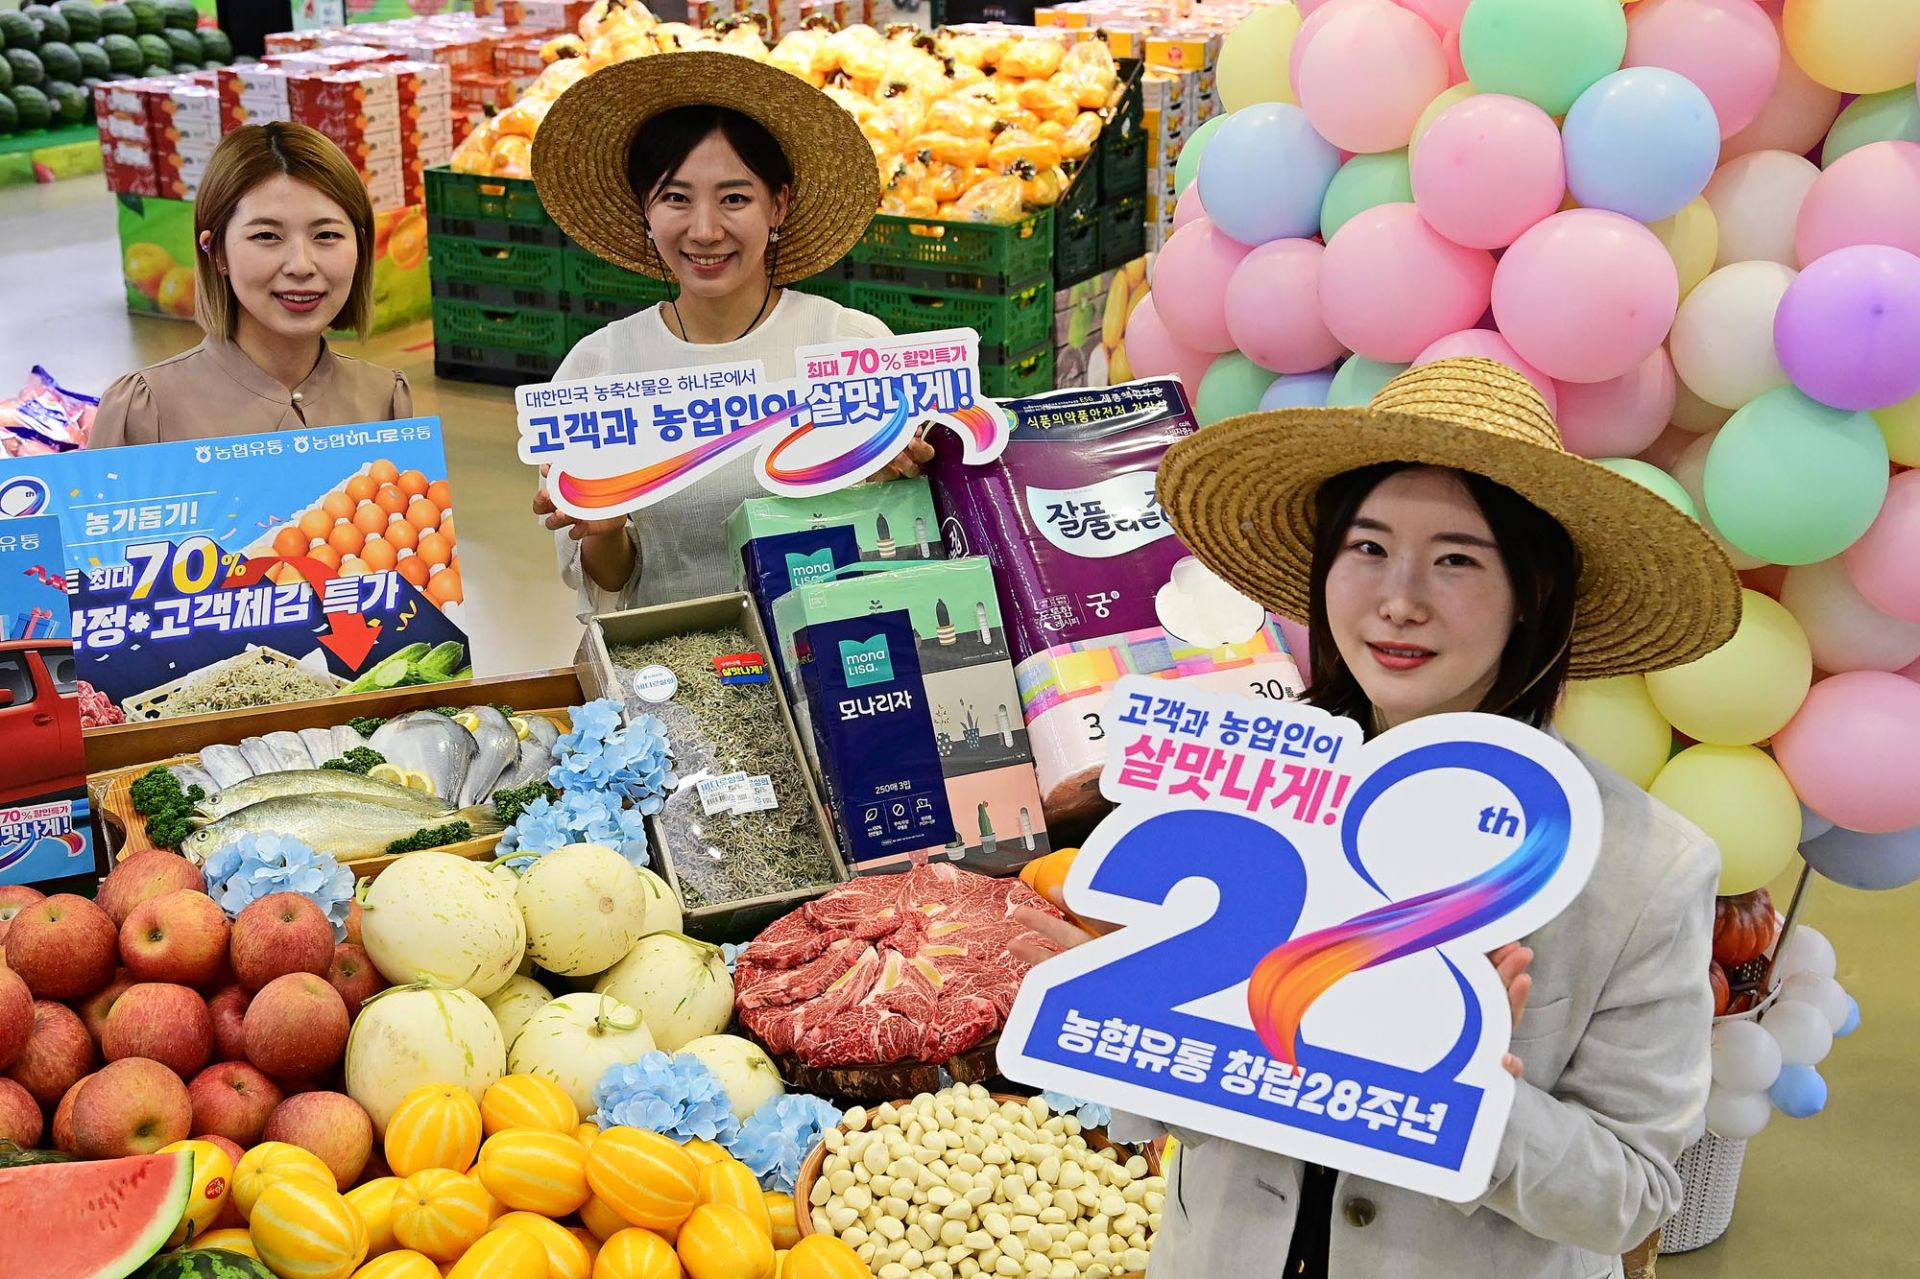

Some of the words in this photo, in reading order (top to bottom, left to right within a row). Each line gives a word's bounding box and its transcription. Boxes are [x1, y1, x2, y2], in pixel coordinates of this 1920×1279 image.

[807, 360, 839, 379] 최대
[842, 348, 902, 377] 70%
[903, 344, 968, 367] 할인특가
[525, 383, 589, 409] 대한민국
[594, 376, 673, 403] 농축산물은
[677, 367, 756, 392] 하나로에서
[805, 368, 974, 428] 살맛나게!
[529, 405, 638, 453] 고객과
[653, 386, 798, 440] 농업인이
[1027, 403, 1127, 430] 식품의약품안전처
[215, 439, 283, 461] 농협유통
[312, 425, 432, 450] 농협하나로유통
[85, 501, 197, 537] 농가돕기!
[0, 533, 40, 553] 유통
[89, 566, 134, 591] 최대
[126, 535, 247, 601] 70%
[793, 562, 831, 577] mona
[323, 571, 400, 614] 특가
[721, 665, 763, 677] 살맛나게!
[845, 649, 886, 665] mona
[839, 690, 912, 721] 모나리자
[1118, 692, 1210, 738] 고객과
[1219, 711, 1344, 765] 농업인이
[875, 783, 898, 795] 250매
[899, 780, 912, 791] 3입
[1117, 734, 1352, 827] 살맛나게!
[34, 805, 69, 818] 할인특가
[1477, 806, 1521, 839] th
[0, 816, 71, 846] 맛나게!
[1057, 1009, 1217, 1085] 농협유통
[1221, 1048, 1449, 1146] 창립28주년
